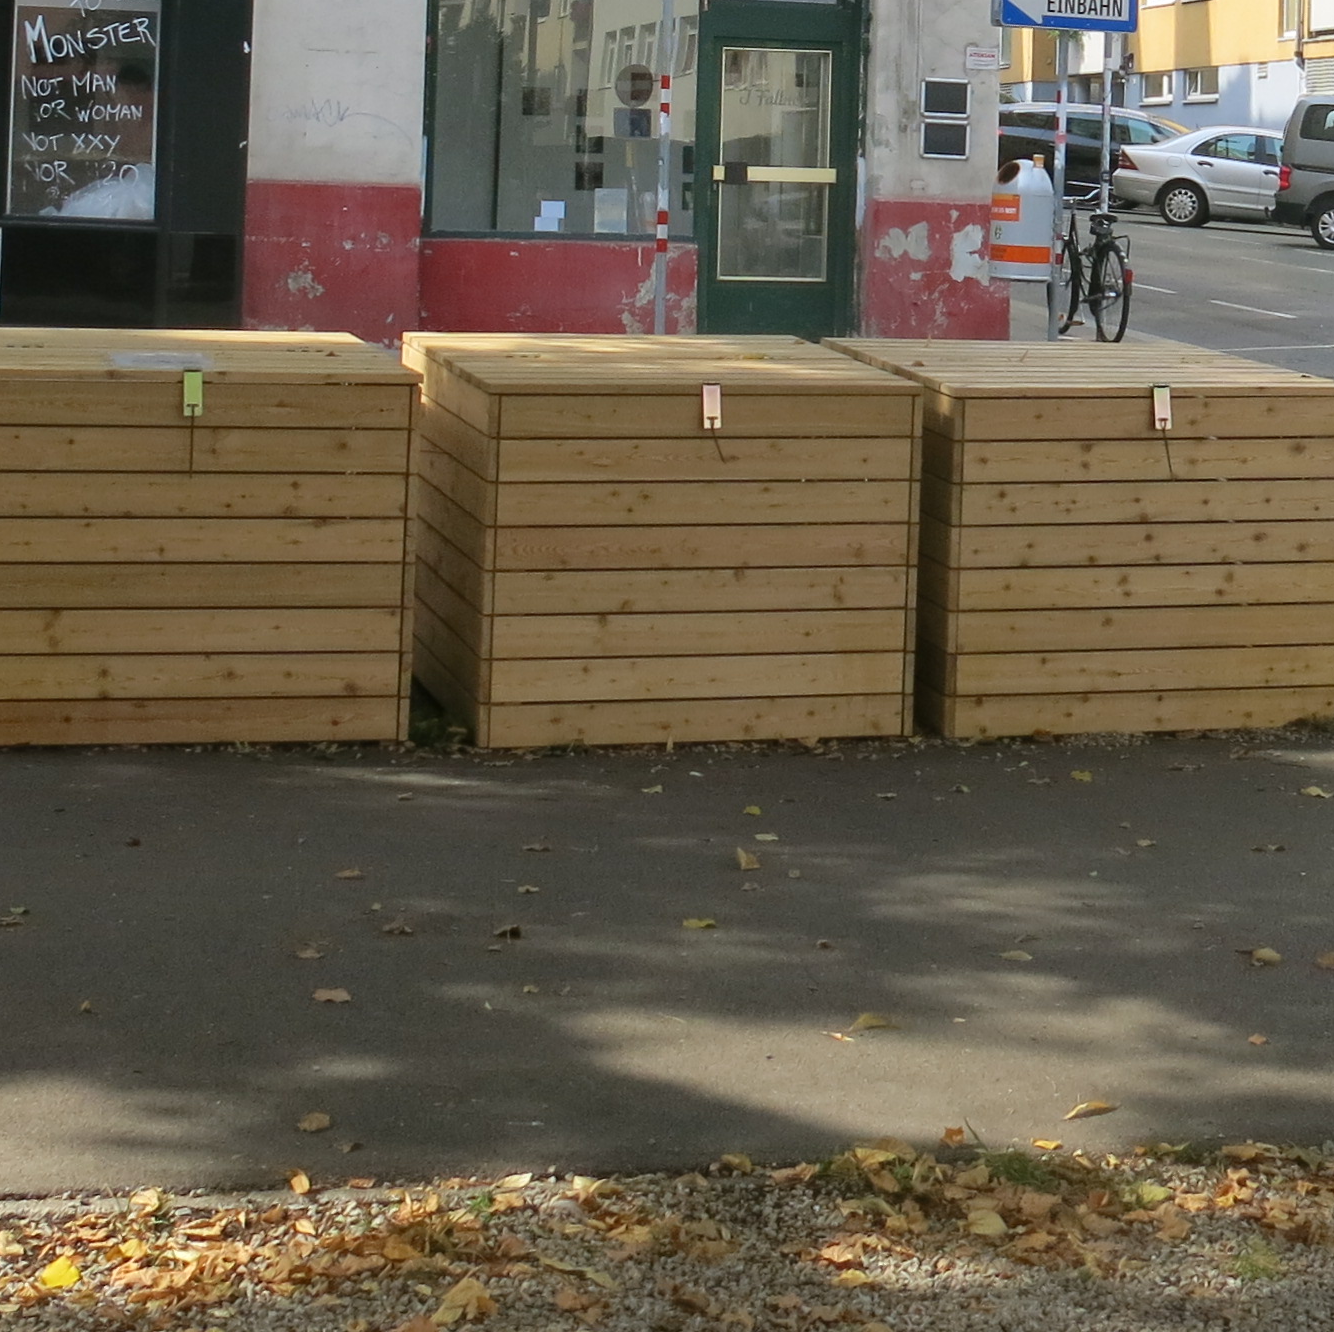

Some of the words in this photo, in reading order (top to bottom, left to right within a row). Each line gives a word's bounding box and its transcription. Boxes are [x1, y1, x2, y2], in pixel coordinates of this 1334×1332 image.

[24, 14, 156, 64] MONSTER
[21, 74, 64, 100] NOT
[72, 71, 116, 96] MAN
[75, 100, 143, 122] WOMAN
[22, 132, 65, 152] NOT
[71, 133, 121, 157] XXY
